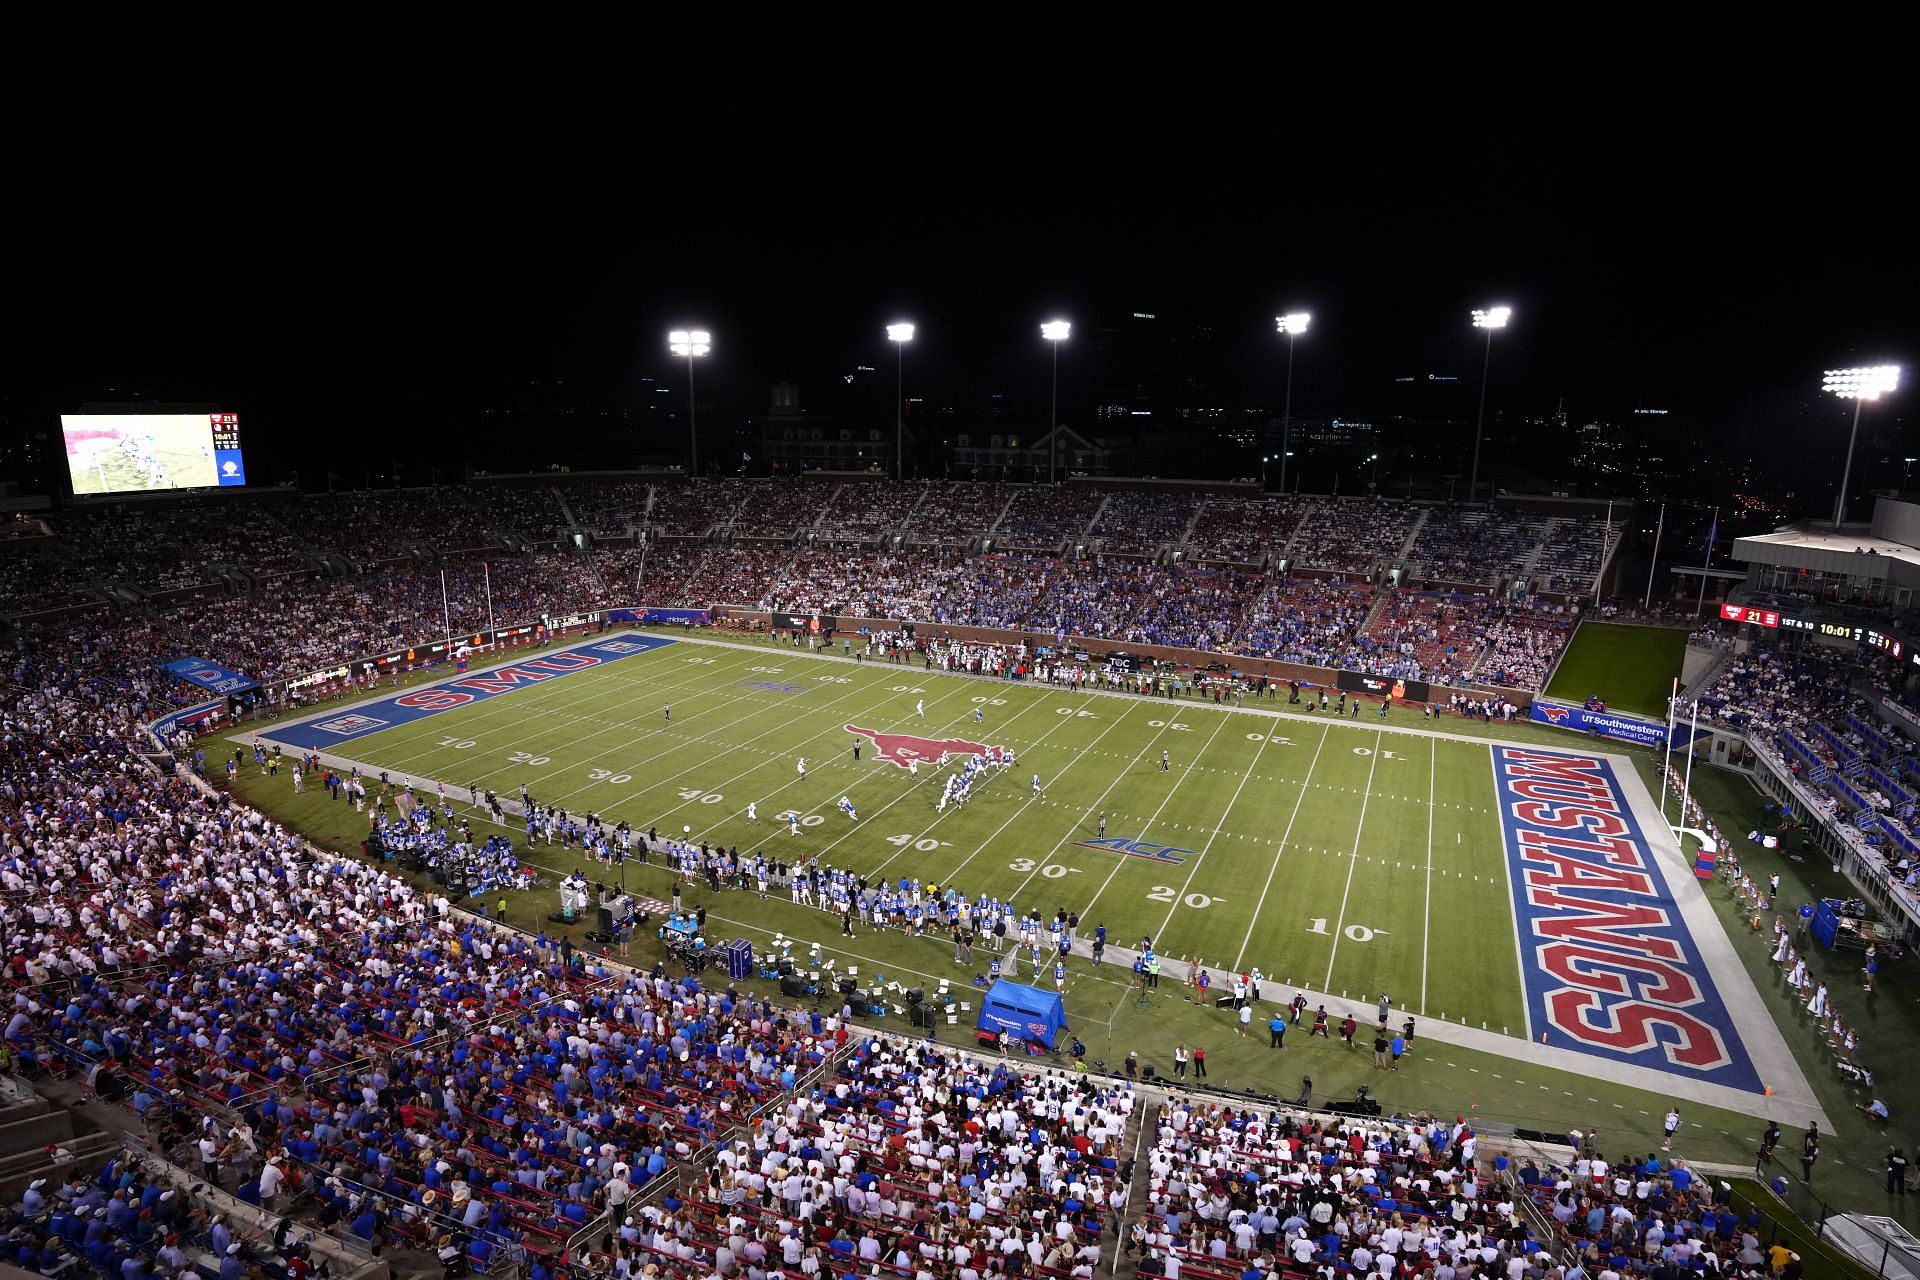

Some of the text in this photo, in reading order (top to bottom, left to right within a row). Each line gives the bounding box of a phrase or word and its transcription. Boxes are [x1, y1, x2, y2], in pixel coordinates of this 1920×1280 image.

[1747, 611, 1761, 622] 21
[1782, 618, 1796, 627] 1ST
[1804, 622, 1813, 630] 10
[1820, 624, 1851, 638] 10:01
[1109, 657, 1130, 668] TOC
[394, 652, 602, 711] SMU
[1608, 728, 1637, 739] Medical
[507, 752, 550, 765] 20
[1352, 747, 1397, 759] 10
[588, 769, 632, 784] 30
[678, 789, 723, 804] 40
[886, 834, 939, 850] 40
[1080, 838, 1200, 863] ACC
[1009, 858, 1067, 878] 30
[1145, 886, 1211, 908] 20
[1506, 747, 1733, 1072] MUSTANGS
[1305, 918, 1374, 942] 10
